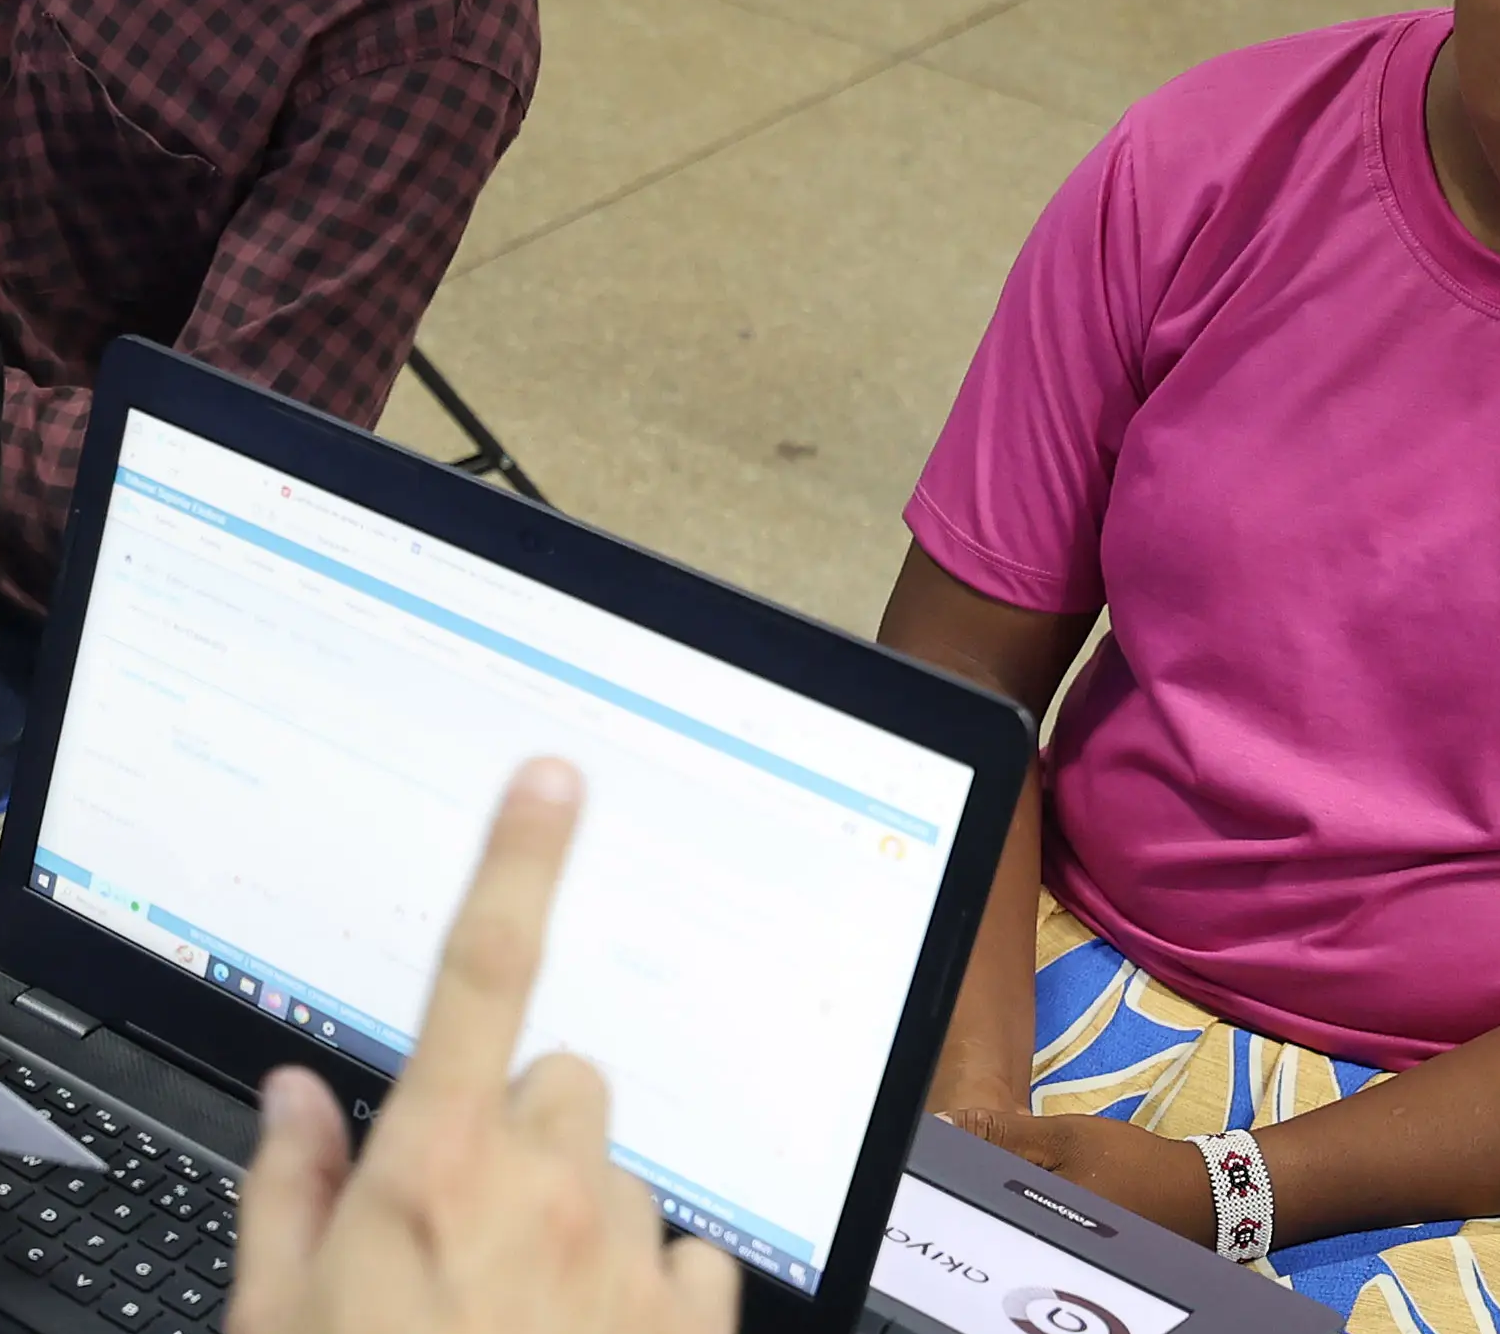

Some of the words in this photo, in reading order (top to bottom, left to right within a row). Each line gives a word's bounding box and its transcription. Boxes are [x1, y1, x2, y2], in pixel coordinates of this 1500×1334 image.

[67, 1178, 85, 1192] E
[40, 1208, 58, 1221] D
[114, 1204, 131, 1218] R
[86, 1235, 105, 1247] F
[163, 1231, 180, 1243] T
[27, 1248, 45, 1261] C
[134, 1262, 152, 1276] G
[212, 1257, 228, 1269] Y
[76, 1274, 93, 1288] V
[182, 1289, 202, 1304] H
[121, 1302, 139, 1317] B
